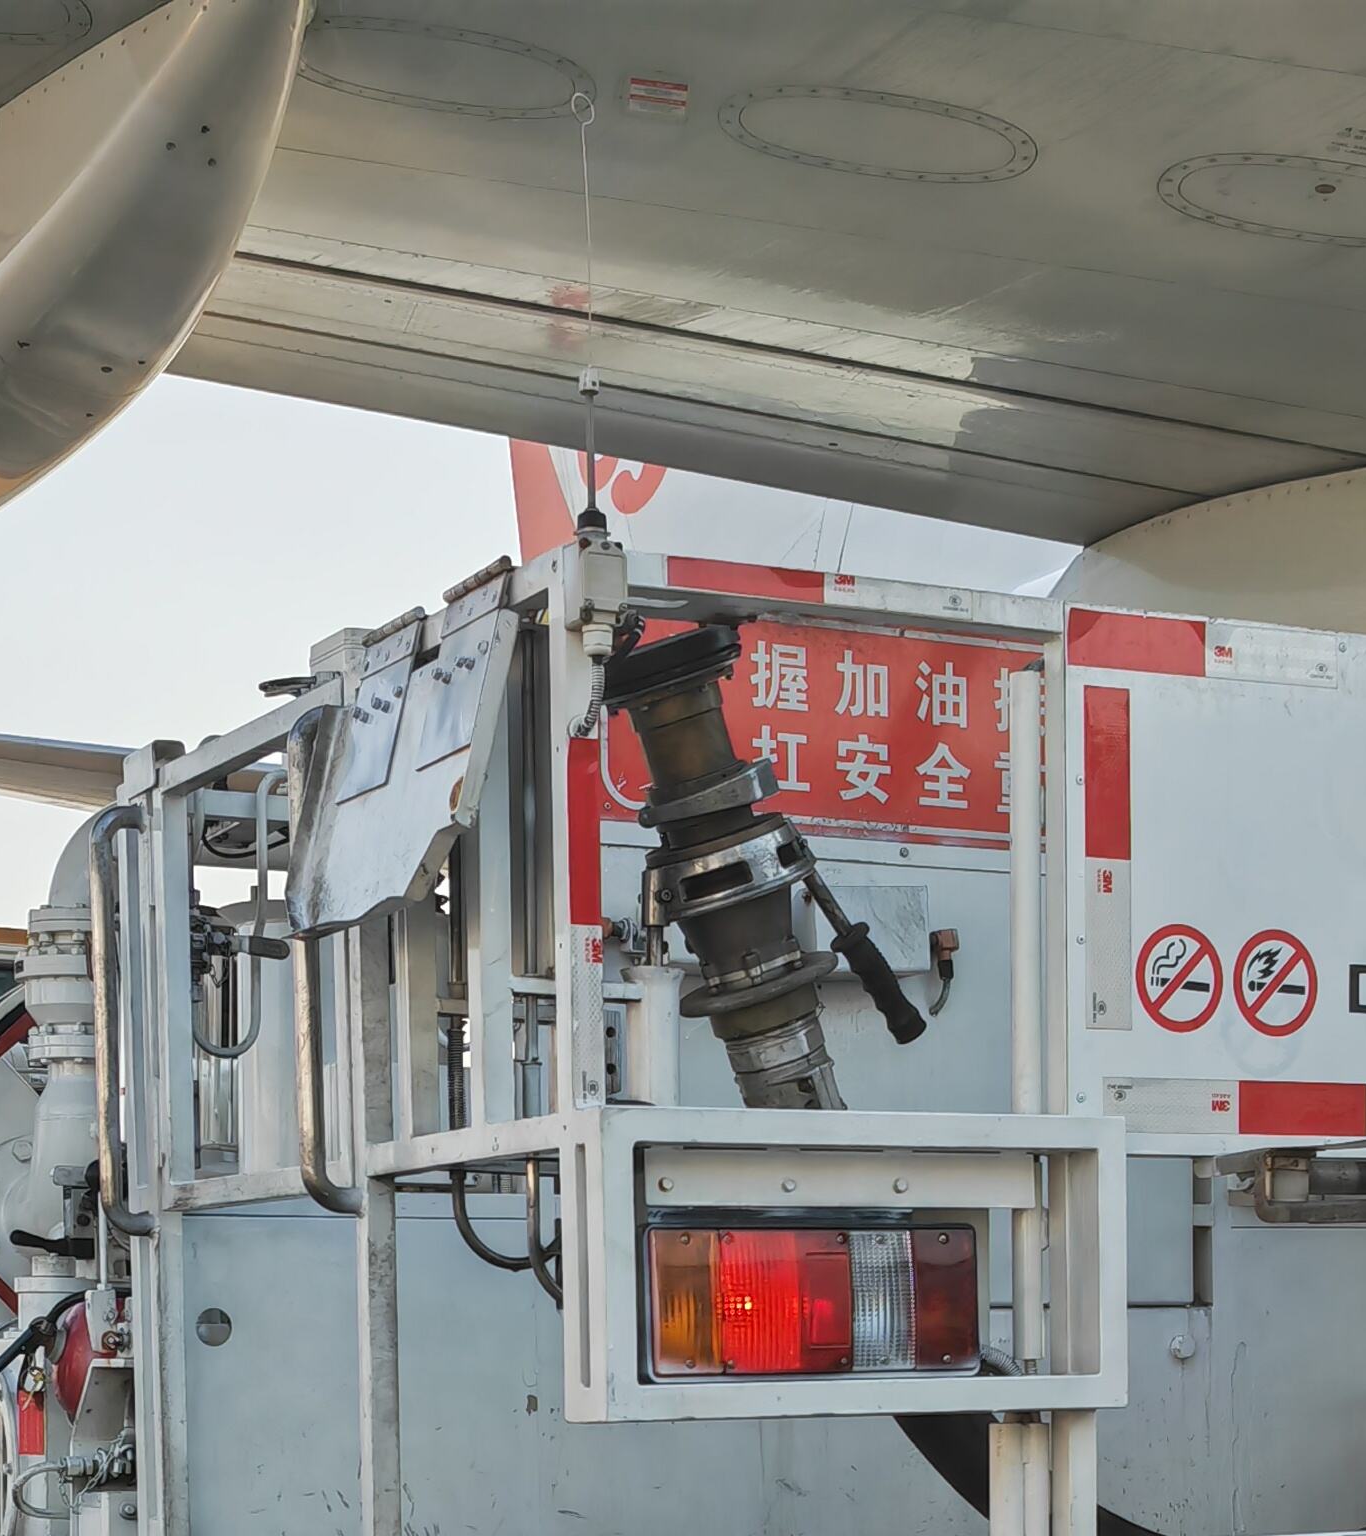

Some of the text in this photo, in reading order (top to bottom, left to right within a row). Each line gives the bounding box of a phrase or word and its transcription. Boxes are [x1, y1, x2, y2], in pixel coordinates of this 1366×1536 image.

[1213, 645, 1234, 659] 3M
[1102, 869, 1113, 894] 3M
[591, 937, 603, 964] 3M
[1211, 1099, 1230, 1112] 3M
